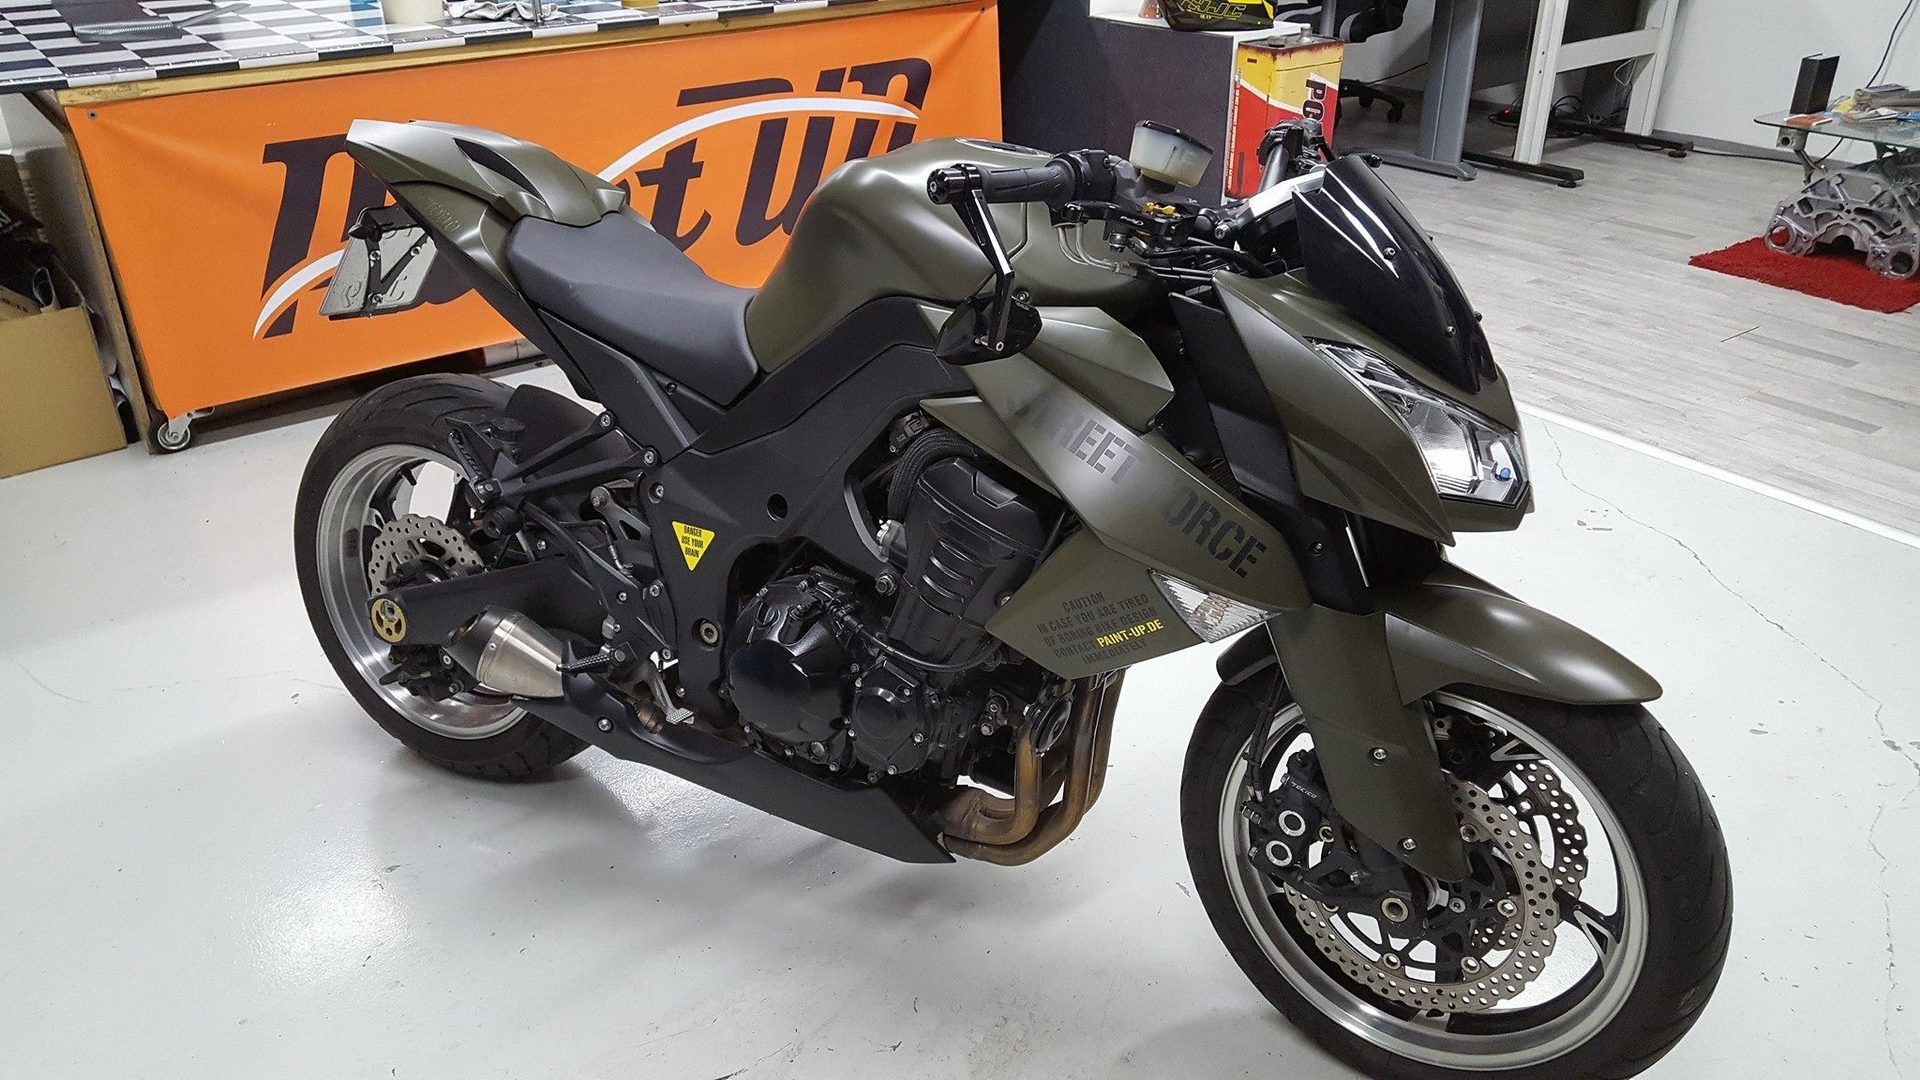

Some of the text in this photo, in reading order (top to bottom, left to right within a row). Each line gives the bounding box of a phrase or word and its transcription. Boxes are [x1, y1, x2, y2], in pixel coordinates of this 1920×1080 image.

[1036, 593, 1149, 635] IN CASE YOU ARE TIRED
[1062, 590, 1106, 614] CAUTION
[1095, 620, 1120, 635] BIKE
[1121, 606, 1158, 626] DESIGN
[1054, 619, 1164, 659] CONTACT PAINT-UP.DE
[1081, 638, 1147, 665] IMMEDIATELY
